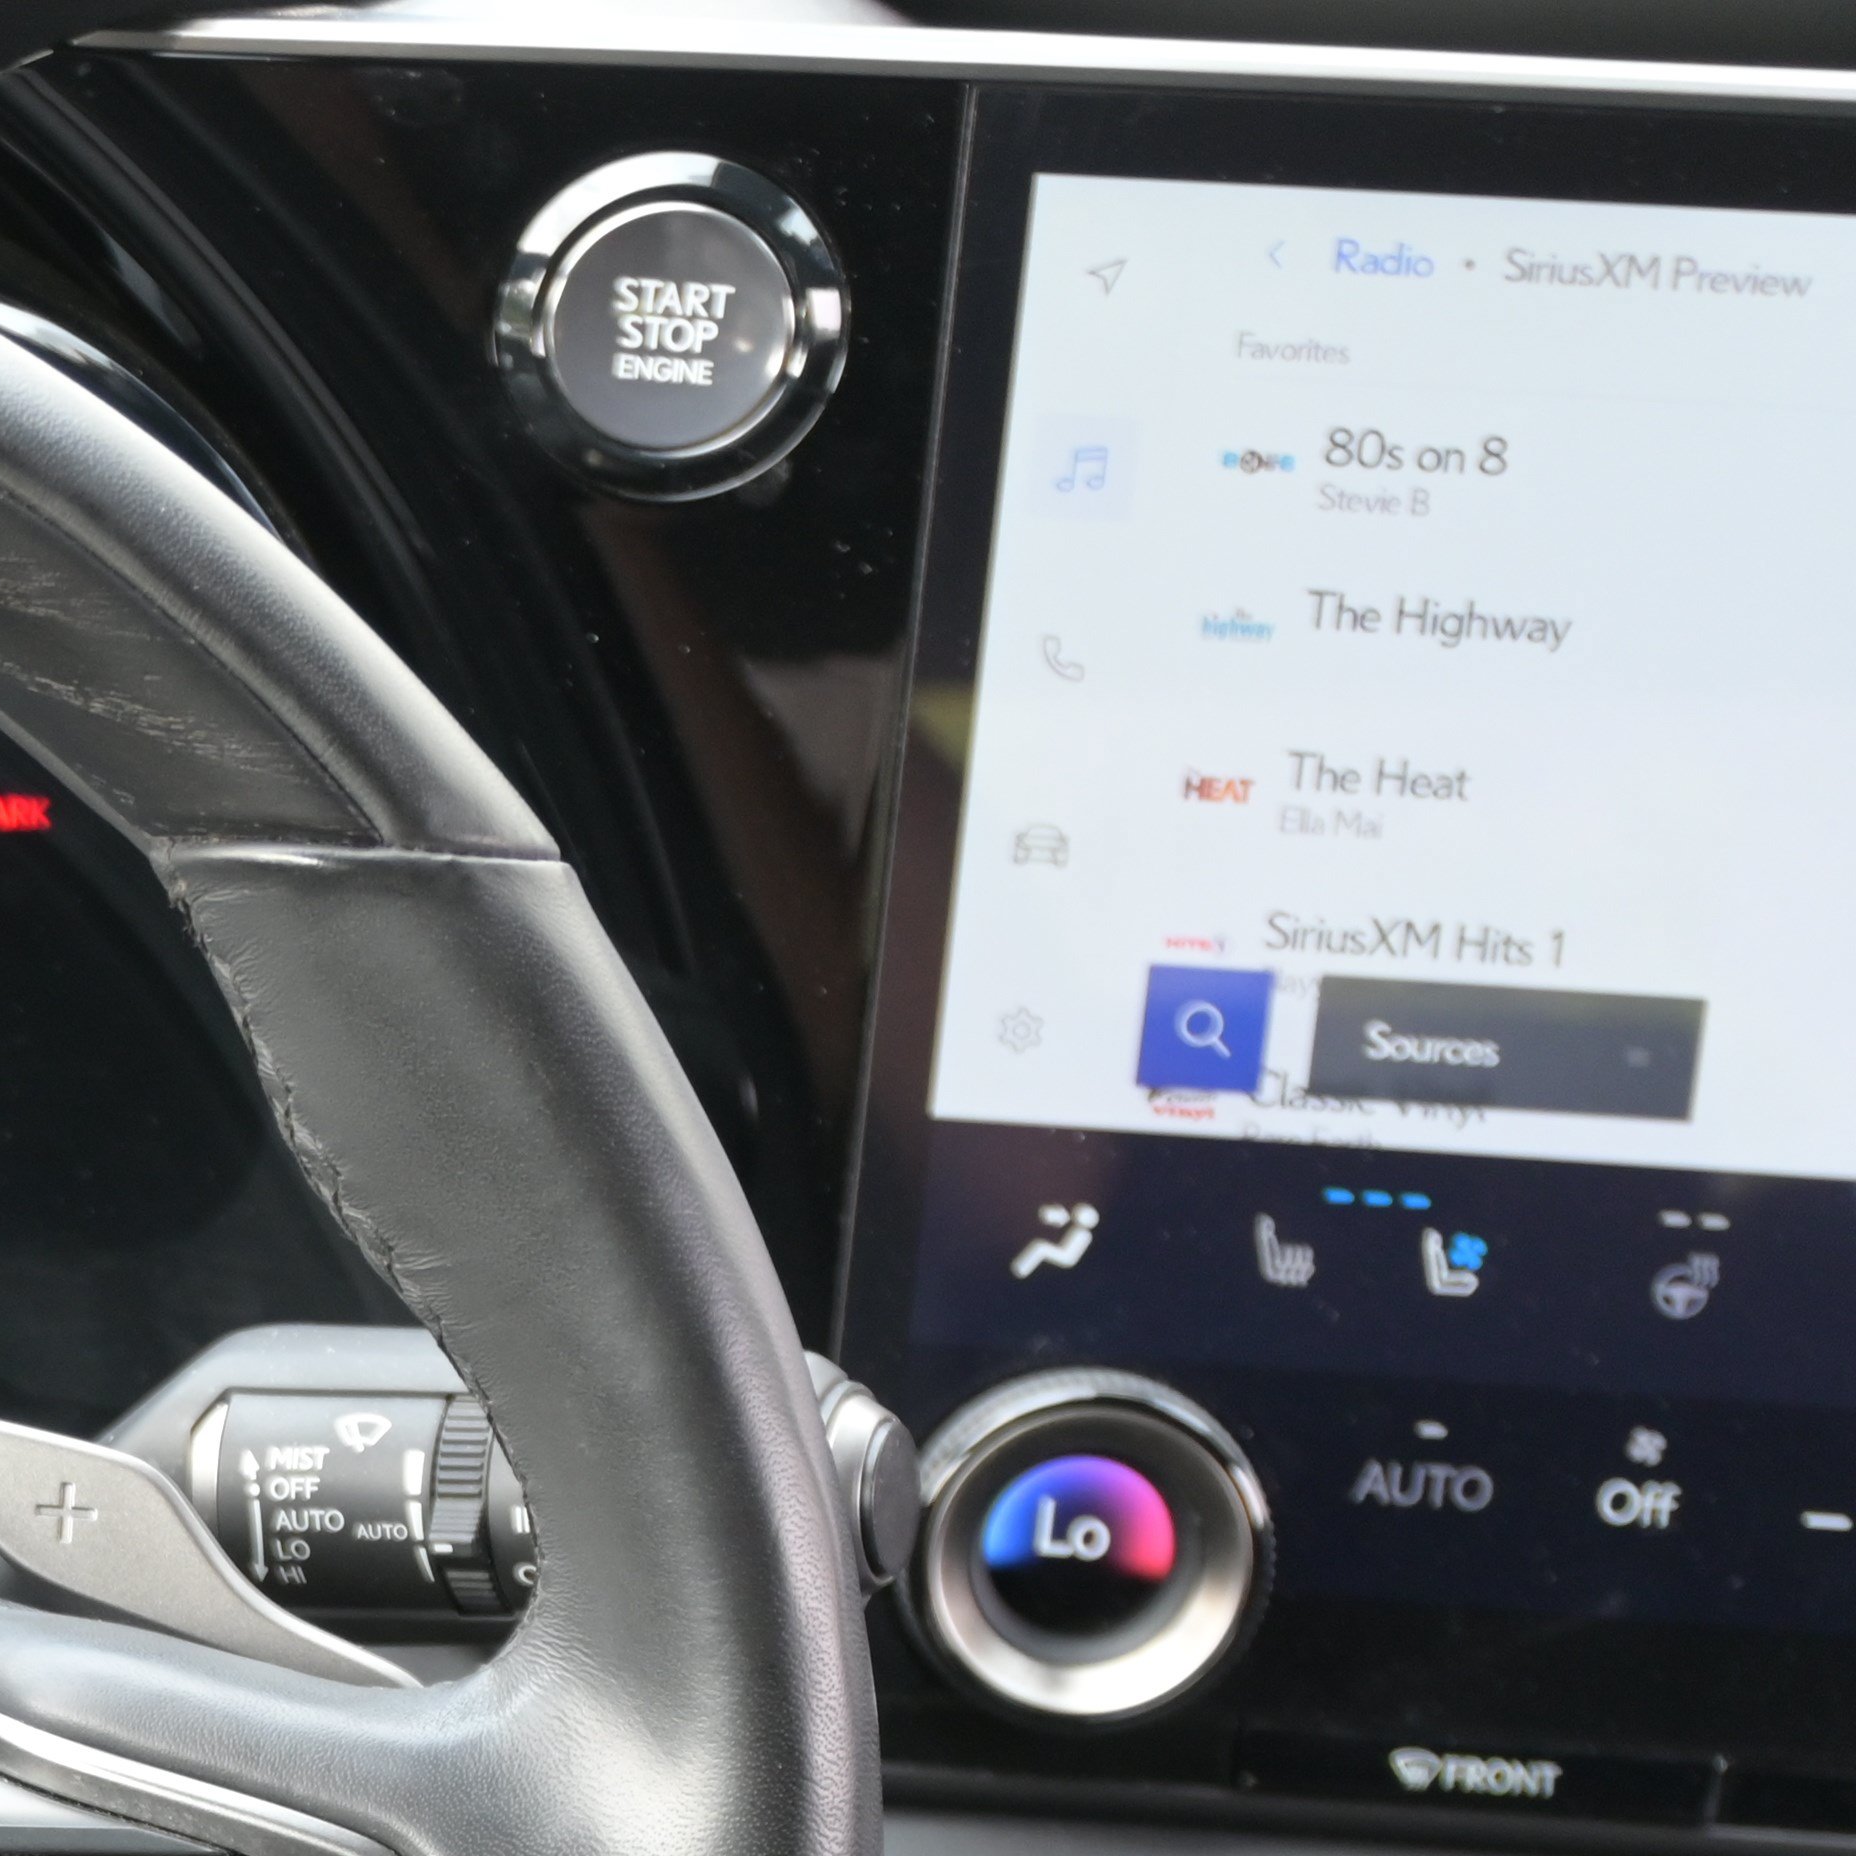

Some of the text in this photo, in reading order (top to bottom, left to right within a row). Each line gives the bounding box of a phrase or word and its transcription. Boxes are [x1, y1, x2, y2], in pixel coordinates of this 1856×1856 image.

[1333, 238, 1814, 299] Radio SiriusXM Preview
[613, 276, 736, 320] START
[617, 315, 719, 353] STOP
[1234, 330, 1351, 367] Favorites
[612, 353, 714, 385] ENGINE
[1323, 427, 1405, 471] 80s
[1416, 446, 1466, 473] on
[1478, 434, 1508, 477] 8
[1317, 483, 1431, 517] Stevie B
[1307, 587, 1572, 653] The Highway
[1286, 749, 1472, 802] The Heat
[1263, 910, 1567, 969] SiriusXM Hits 1
[1363, 1019, 1501, 1069] Sources
[269, 1445, 331, 1471] MIST
[269, 1477, 319, 1500] OFF
[1351, 1459, 1494, 1512] AUTO
[1596, 1477, 1682, 1528] Off
[275, 1508, 345, 1532] AUTO
[357, 1522, 408, 1540] AUTO
[1034, 1498, 1110, 1562] Lo
[277, 1538, 311, 1560] LO
[280, 1563, 307, 1584] HI
[1438, 1757, 1561, 1799] FRONT
